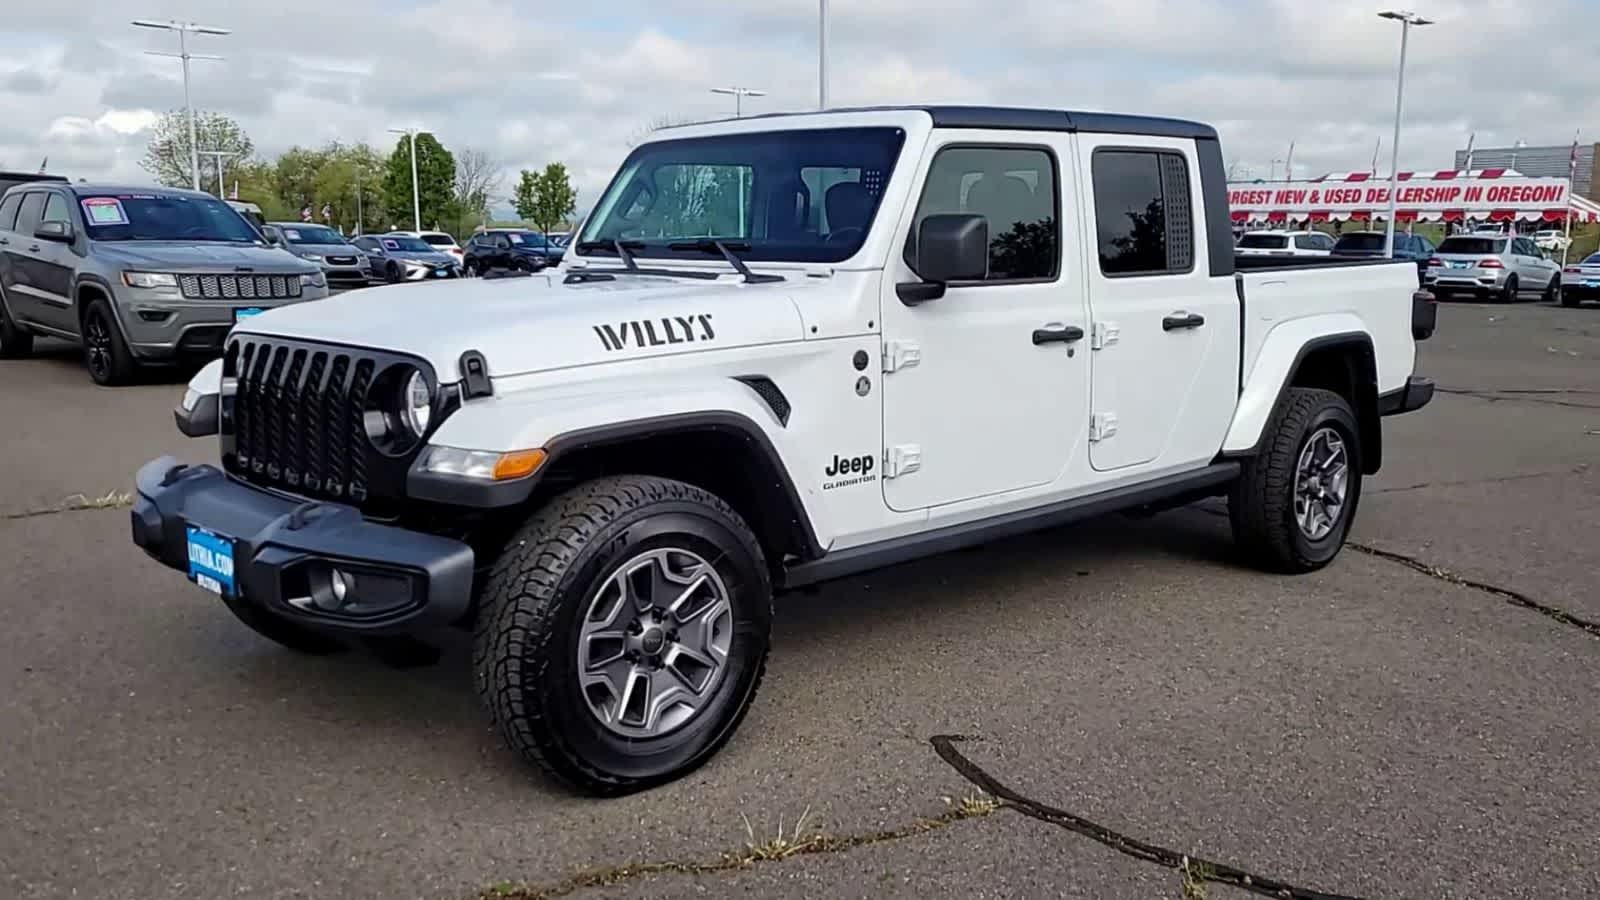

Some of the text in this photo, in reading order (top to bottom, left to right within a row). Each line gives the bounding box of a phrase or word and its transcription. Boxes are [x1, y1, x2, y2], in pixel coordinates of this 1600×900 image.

[1274, 189, 1307, 205] NEW
[1309, 189, 1321, 204] &
[1324, 188, 1361, 204] USED
[1365, 186, 1461, 204] DEALERSHIP
[1464, 186, 1484, 202] IN
[1486, 185, 1563, 202] OREGON!
[592, 314, 714, 351] WILLYS
[825, 454, 874, 477] Jeep
[823, 474, 876, 490] GLADIATOR
